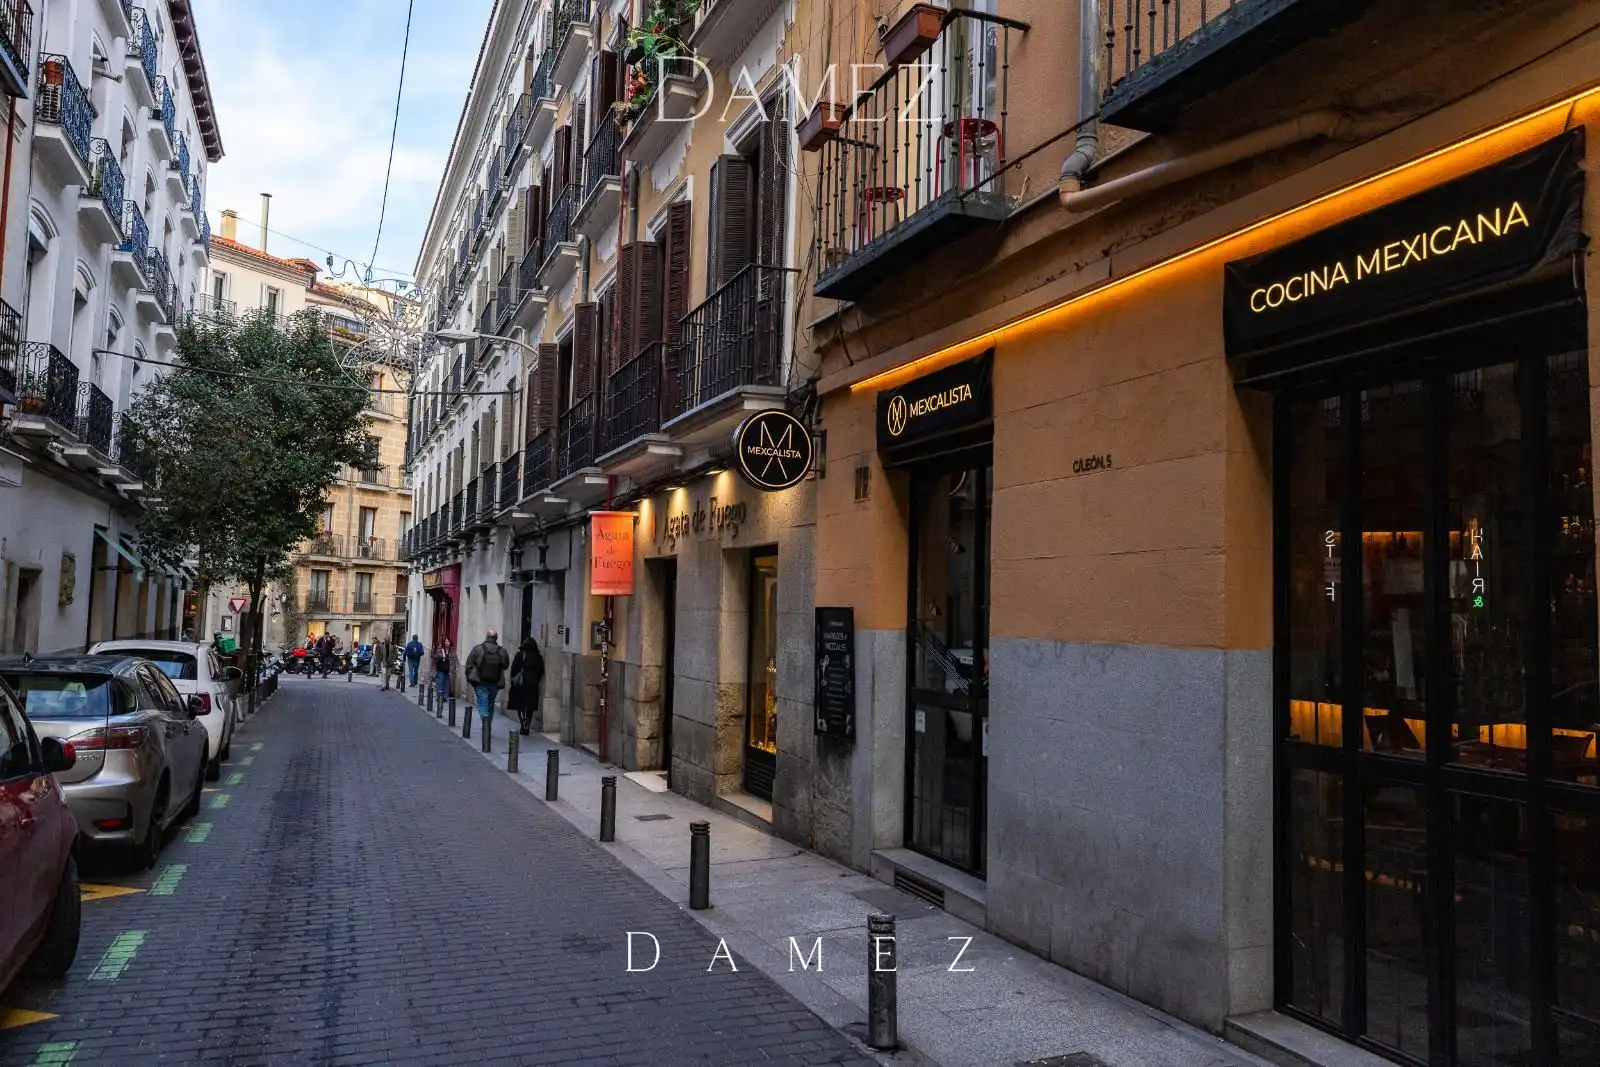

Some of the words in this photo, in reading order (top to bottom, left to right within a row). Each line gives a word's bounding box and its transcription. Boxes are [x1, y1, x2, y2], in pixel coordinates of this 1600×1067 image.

[1250, 261, 1349, 313] COCINA
[1357, 201, 1529, 280] MEXICANA
[909, 383, 972, 418] MEXCALISTA
[747, 445, 802, 459] MEXCALISTA
[594, 556, 631, 571] Fuego
